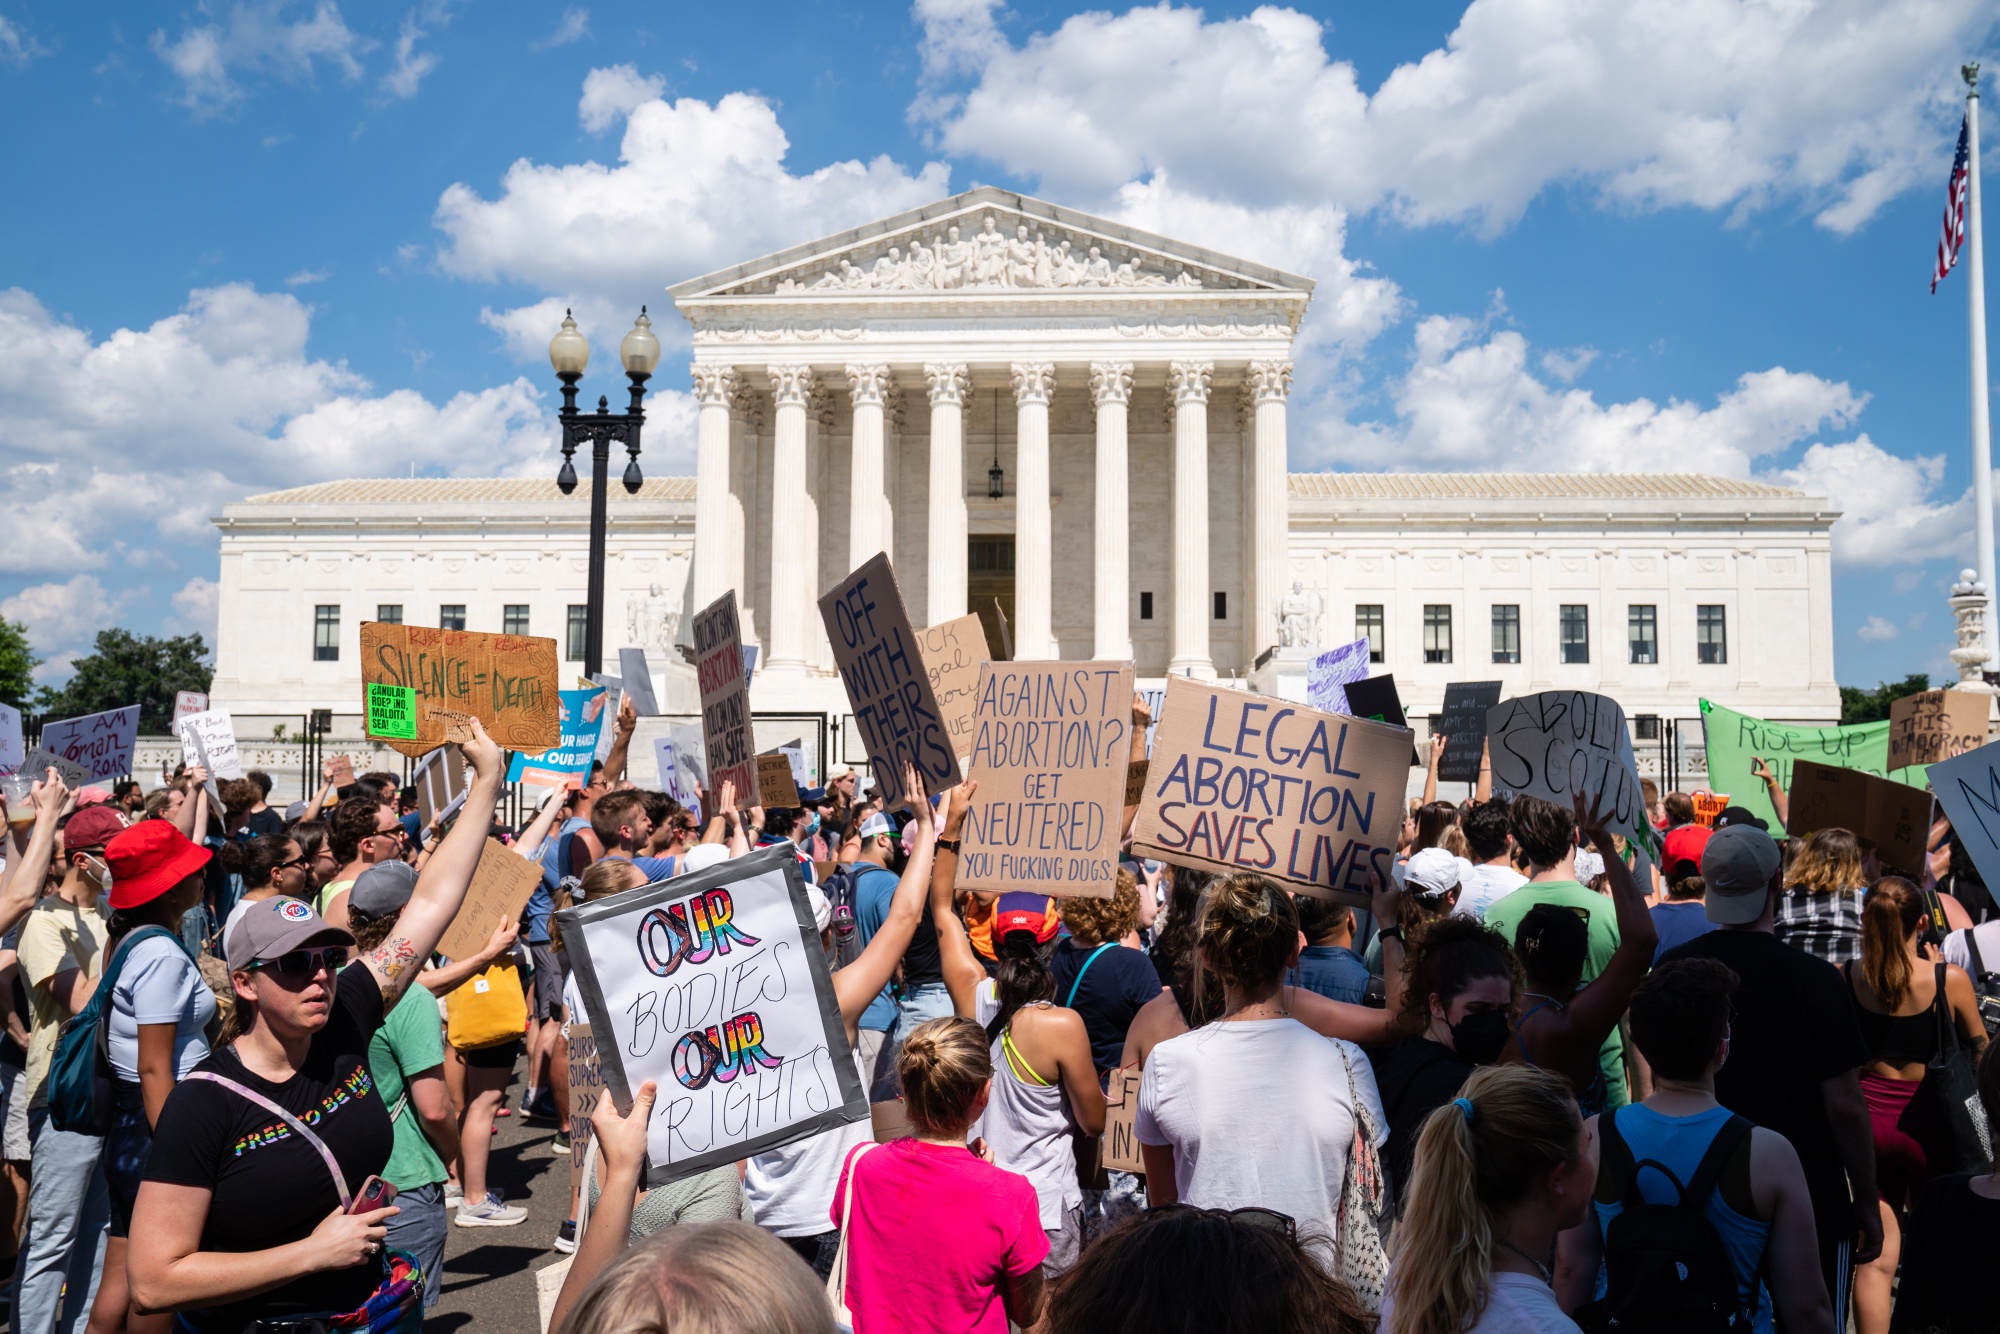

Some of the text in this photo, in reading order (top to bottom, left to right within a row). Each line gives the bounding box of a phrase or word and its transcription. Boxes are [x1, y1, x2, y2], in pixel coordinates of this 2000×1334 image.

[940, 323, 999, 335] JUSTICE
[1009, 322, 1063, 335] UNDER
[1070, 322, 1101, 335] LAW
[718, 602, 735, 642] BAN
[835, 578, 876, 648] OFF
[409, 626, 442, 646] RISE
[445, 633, 468, 646] UP
[376, 644, 471, 700] SILENCE
[493, 667, 546, 714] DEATH
[699, 641, 740, 697] ABORTION
[842, 627, 912, 702] WITH
[929, 648, 971, 690] gal
[186, 696, 198, 705] NO
[371, 685, 406, 699] ¿ANULAR
[371, 697, 392, 708] ROE?
[726, 692, 745, 731] ONLY
[979, 670, 1120, 718] AGAINST
[1911, 698, 1942, 715] IS
[62, 710, 127, 740] I AM
[372, 707, 406, 720] MALDITA
[372, 719, 389, 729] SEA!
[857, 680, 935, 749] THEIR
[1899, 713, 1953, 733] THIS
[206, 744, 235, 757] RIGHT
[560, 733, 596, 748] UR HANDS
[710, 738, 726, 770] BAN
[725, 726, 747, 767] SAFE
[971, 718, 1124, 769] ABORTION?
[1203, 694, 1360, 780] LEGAL
[1738, 716, 1805, 753] Rise
[1892, 731, 1984, 757] DEMOCRACY
[547, 752, 574, 766] OUR
[574, 752, 594, 766] TERMS
[1023, 773, 1062, 800] GET
[1156, 753, 1376, 835] ABORTION
[964, 800, 1104, 852] NEUTERED
[963, 852, 1114, 882] YOU FUCKING DOGS.
[1156, 801, 1391, 894] SAVES LIVES
[481, 854, 512, 898] Christine
[636, 886, 762, 978] OUR
[626, 941, 790, 1058] BODIES
[569, 1036, 597, 1061] BURR
[670, 1011, 785, 1091] OUR
[235, 1064, 369, 1156] FREE O BE ME
[660, 1044, 832, 1164] RIGHTS
[570, 1114, 593, 1140] SUPR
[573, 1141, 588, 1169] CO
